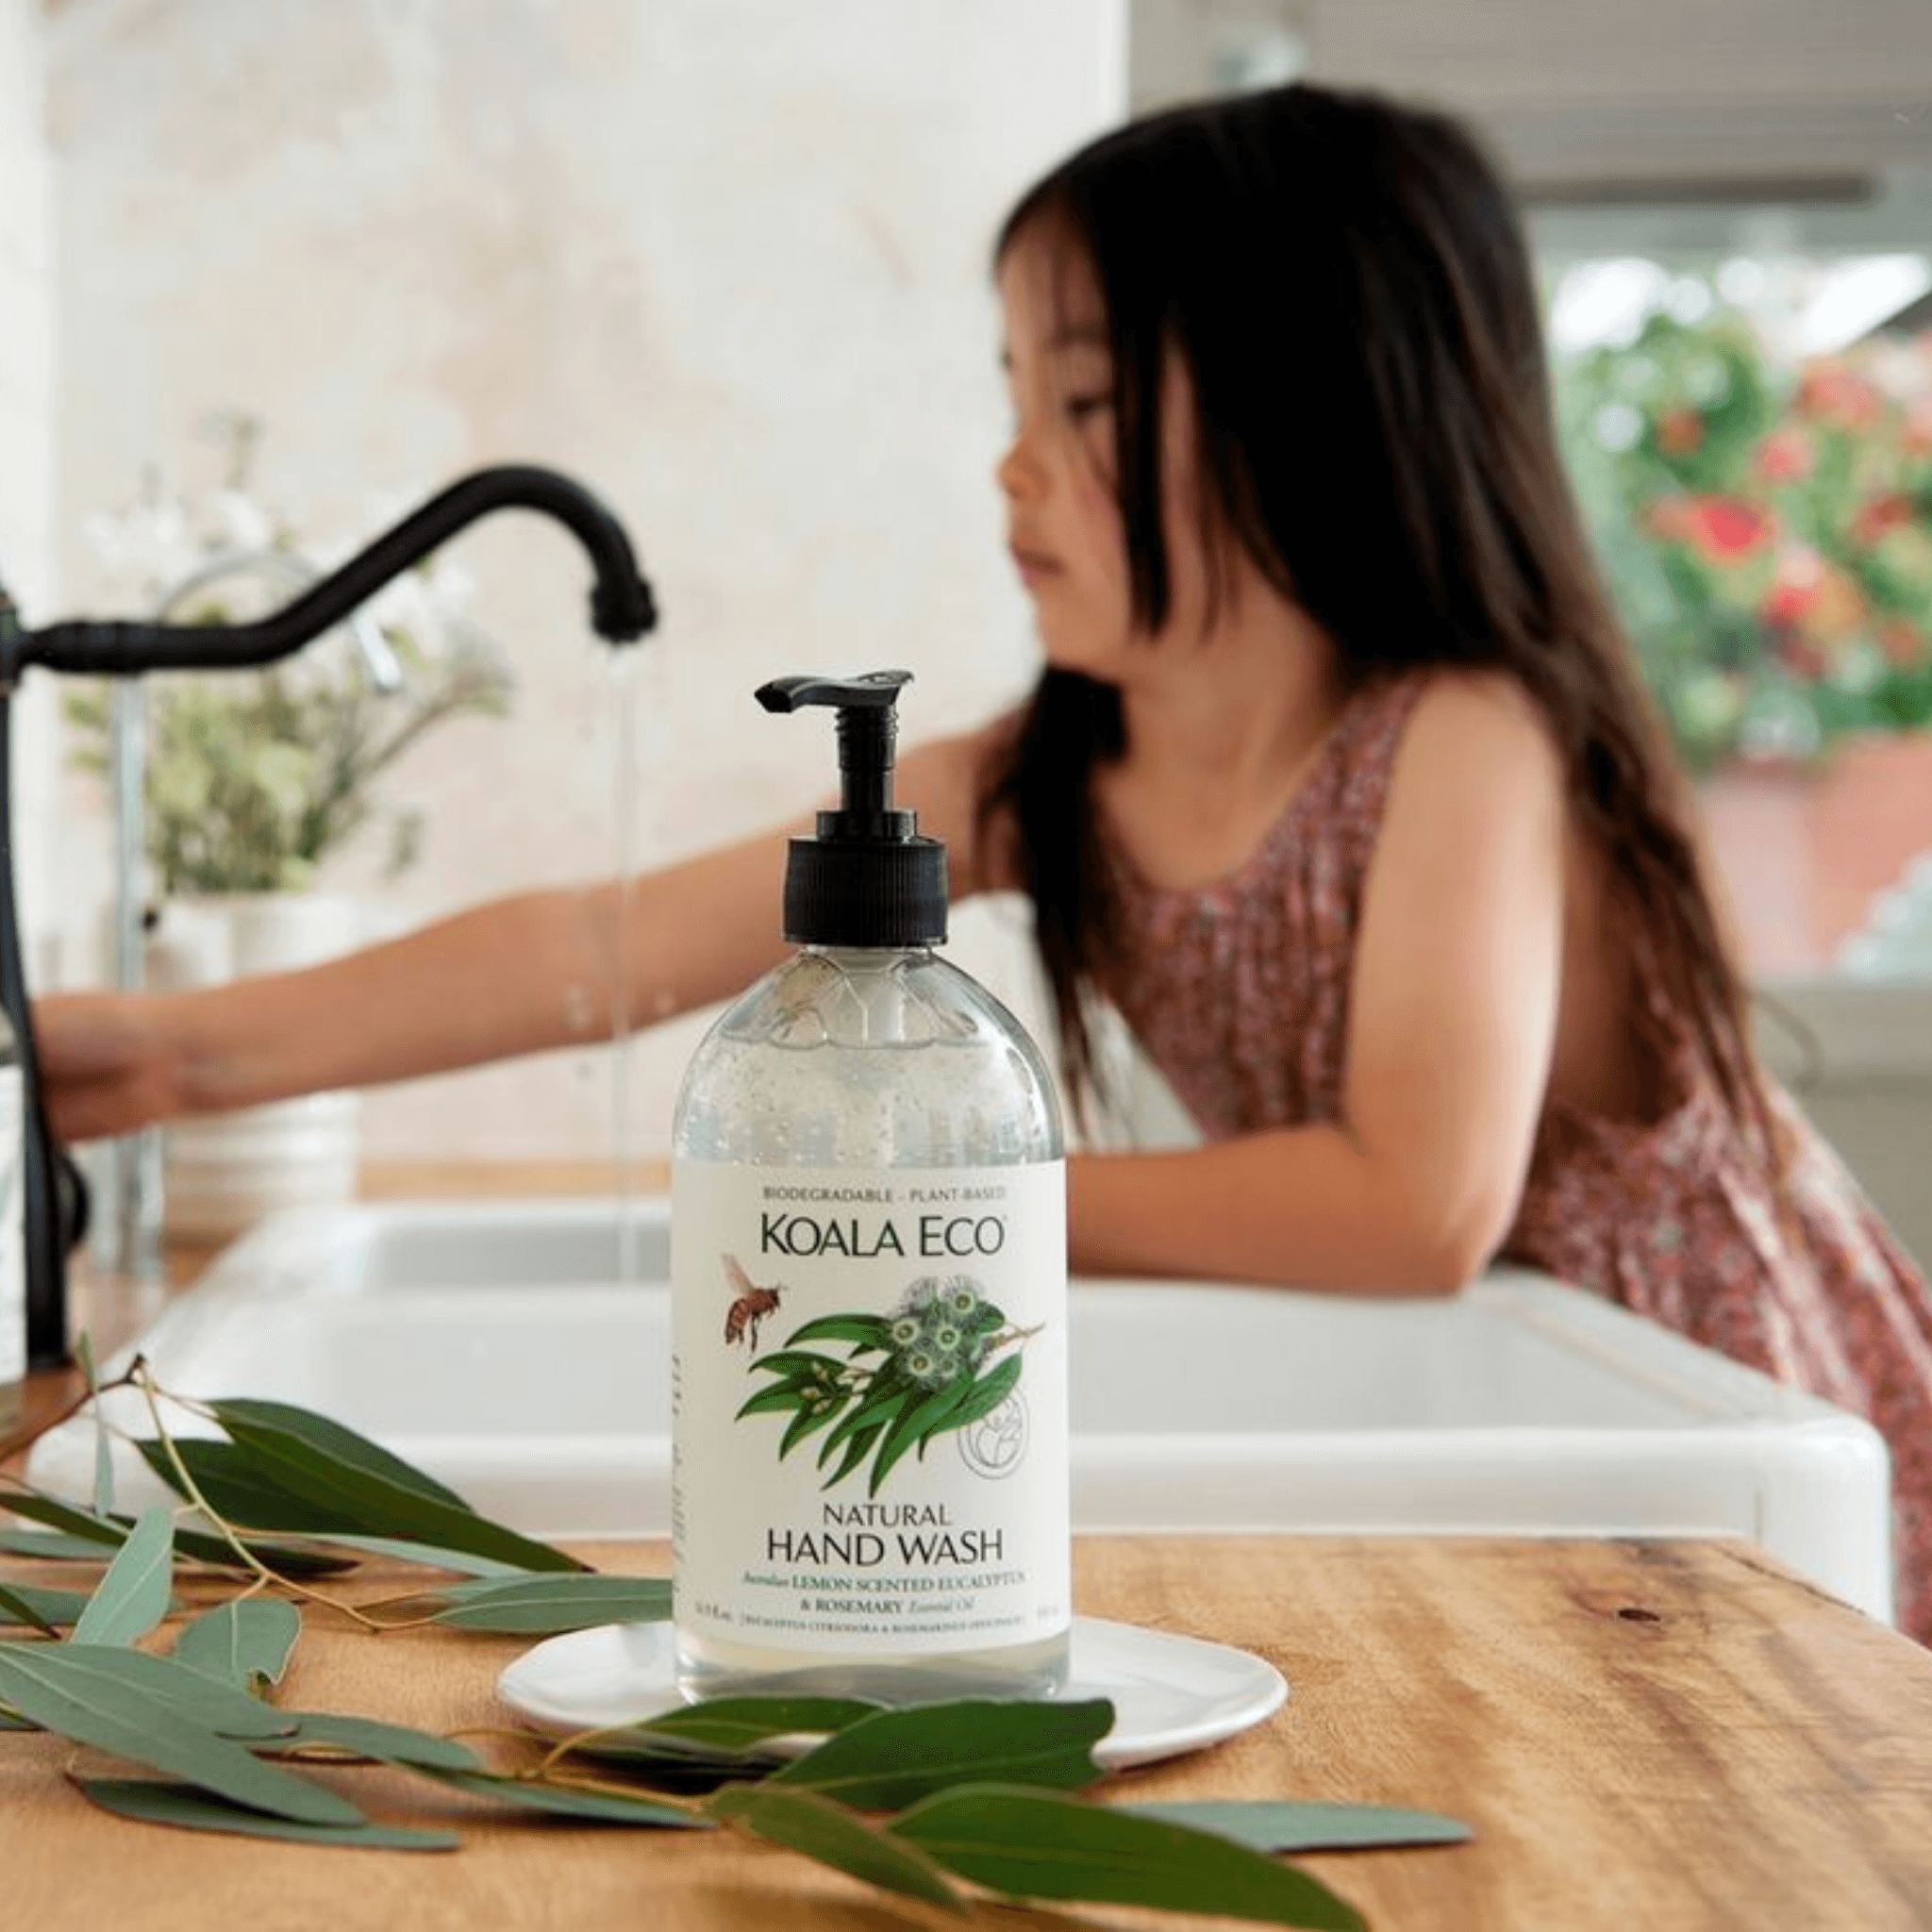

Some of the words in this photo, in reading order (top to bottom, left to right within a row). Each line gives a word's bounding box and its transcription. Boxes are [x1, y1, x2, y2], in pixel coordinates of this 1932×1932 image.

[763, 1186, 892, 1202] BIODEGRADABLE
[761, 1211, 905, 1257] KOALA
[920, 1215, 1005, 1257] ECO
[824, 1503, 953, 1527] NATURAL
[767, 1528, 885, 1567] HAND
[897, 1528, 1003, 1565] WASH
[791, 1574, 851, 1591] LEMON
[857, 1578, 935, 1592] SCENTED
[815, 1598, 903, 1614] ROSEMARY
